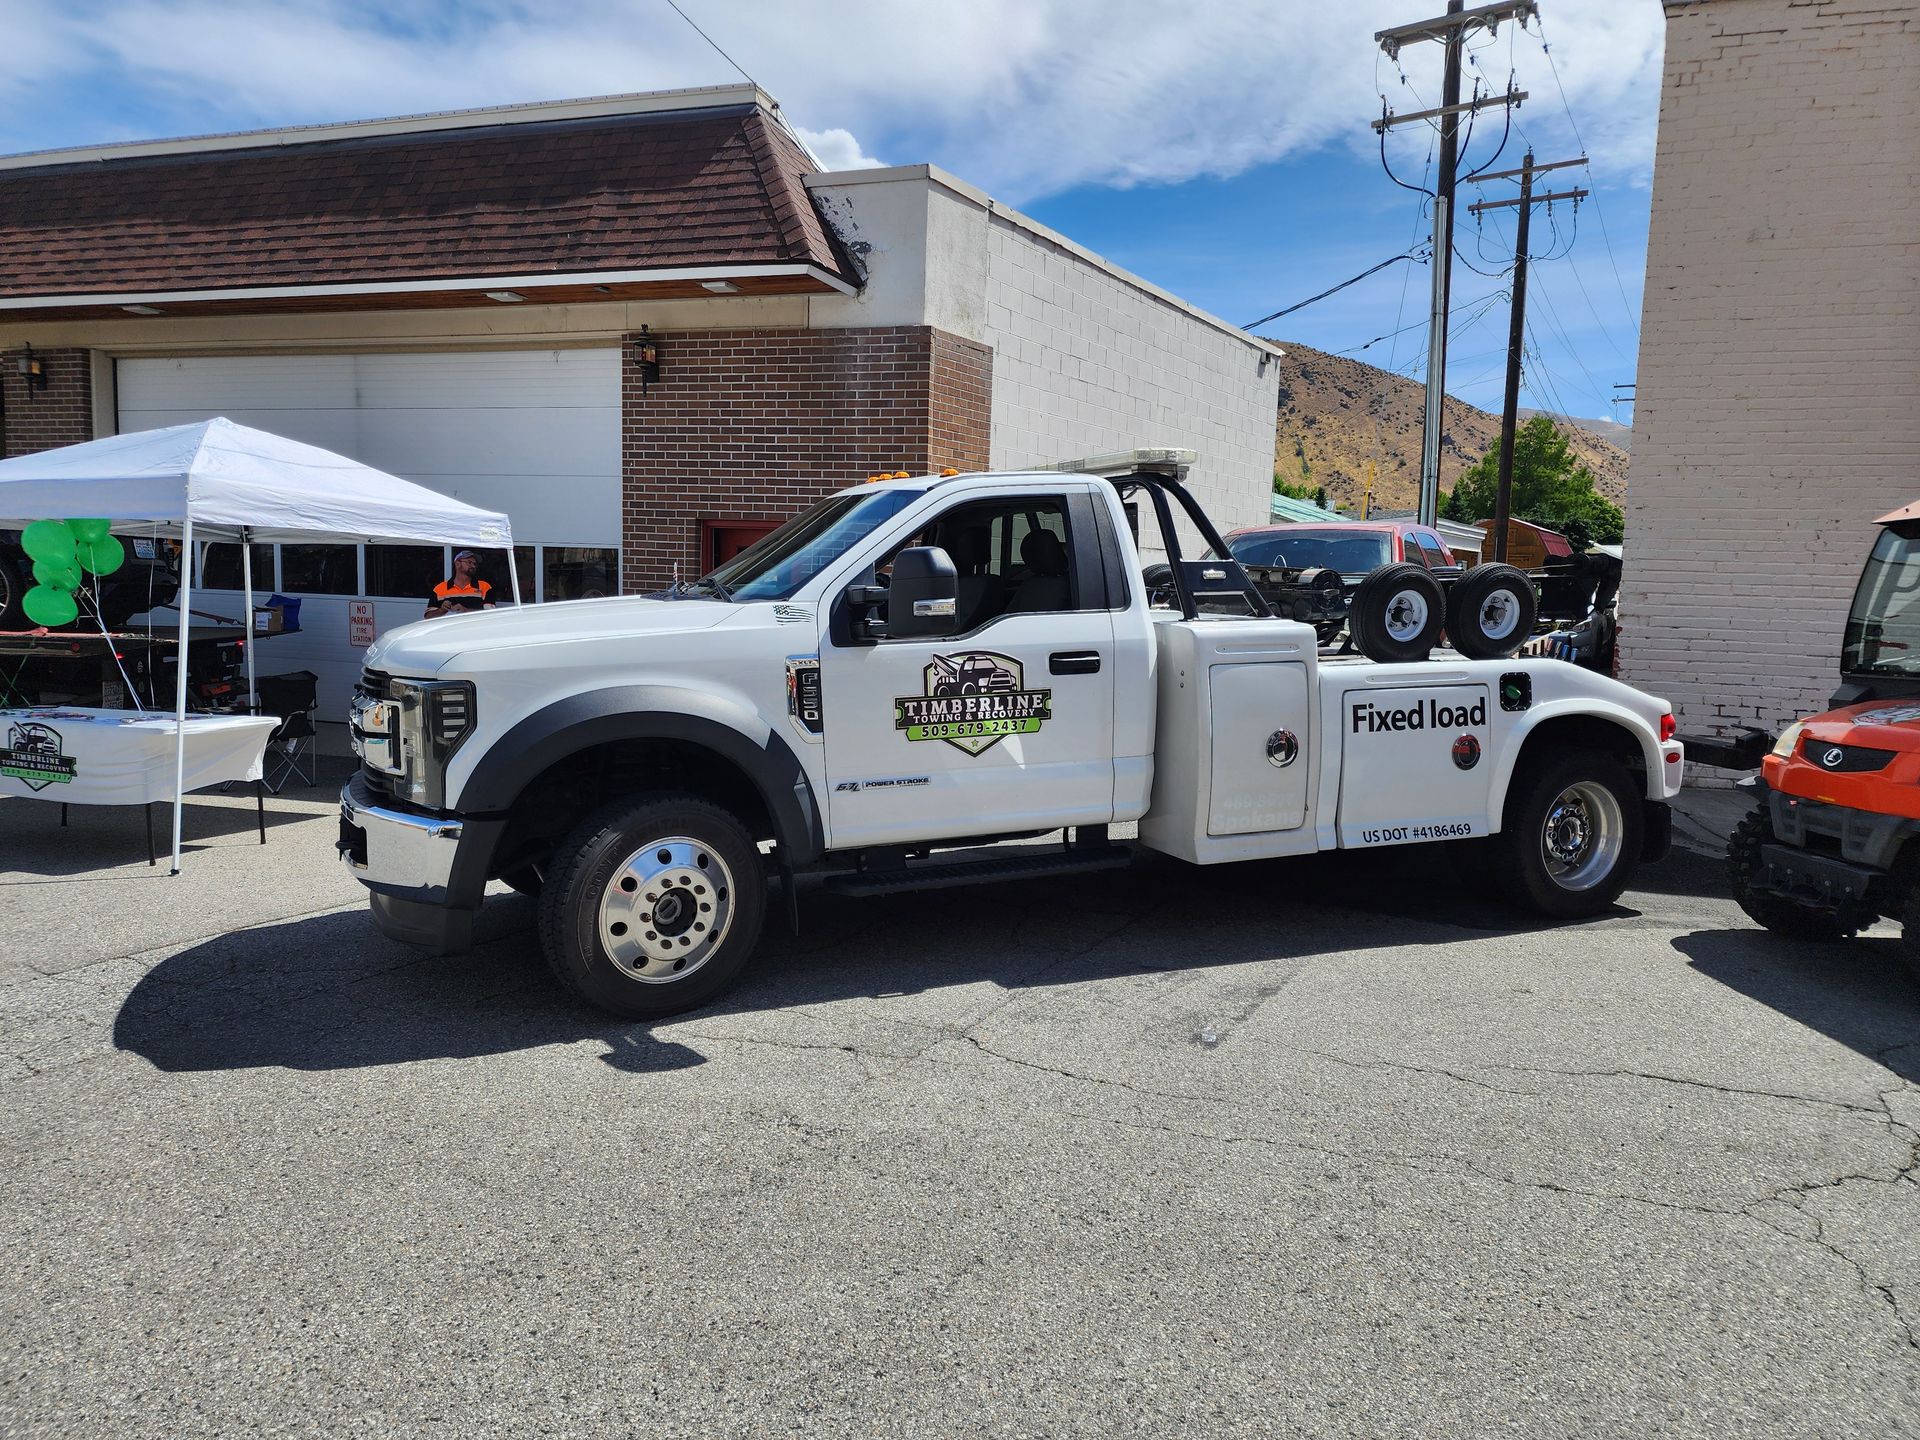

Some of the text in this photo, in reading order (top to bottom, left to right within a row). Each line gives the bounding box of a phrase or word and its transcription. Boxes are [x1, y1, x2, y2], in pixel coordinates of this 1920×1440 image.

[356, 605, 367, 615] NO
[351, 616, 373, 626] PARKING
[352, 635, 372, 643] STATION
[904, 694, 1044, 717] TIMBERLINE
[913, 708, 1035, 724] TOWING & RECOVERY
[1352, 696, 1486, 733] Fixed load
[921, 719, 1028, 738] 509-679-2437
[11, 752, 60, 765] TIMBERLINE
[2, 759, 28, 768] TOWING
[37, 763, 70, 773] RECOVERY
[865, 780, 895, 788] POWER
[896, 777, 929, 785] STROKE
[1362, 823, 1472, 843] US DOT #4186469
